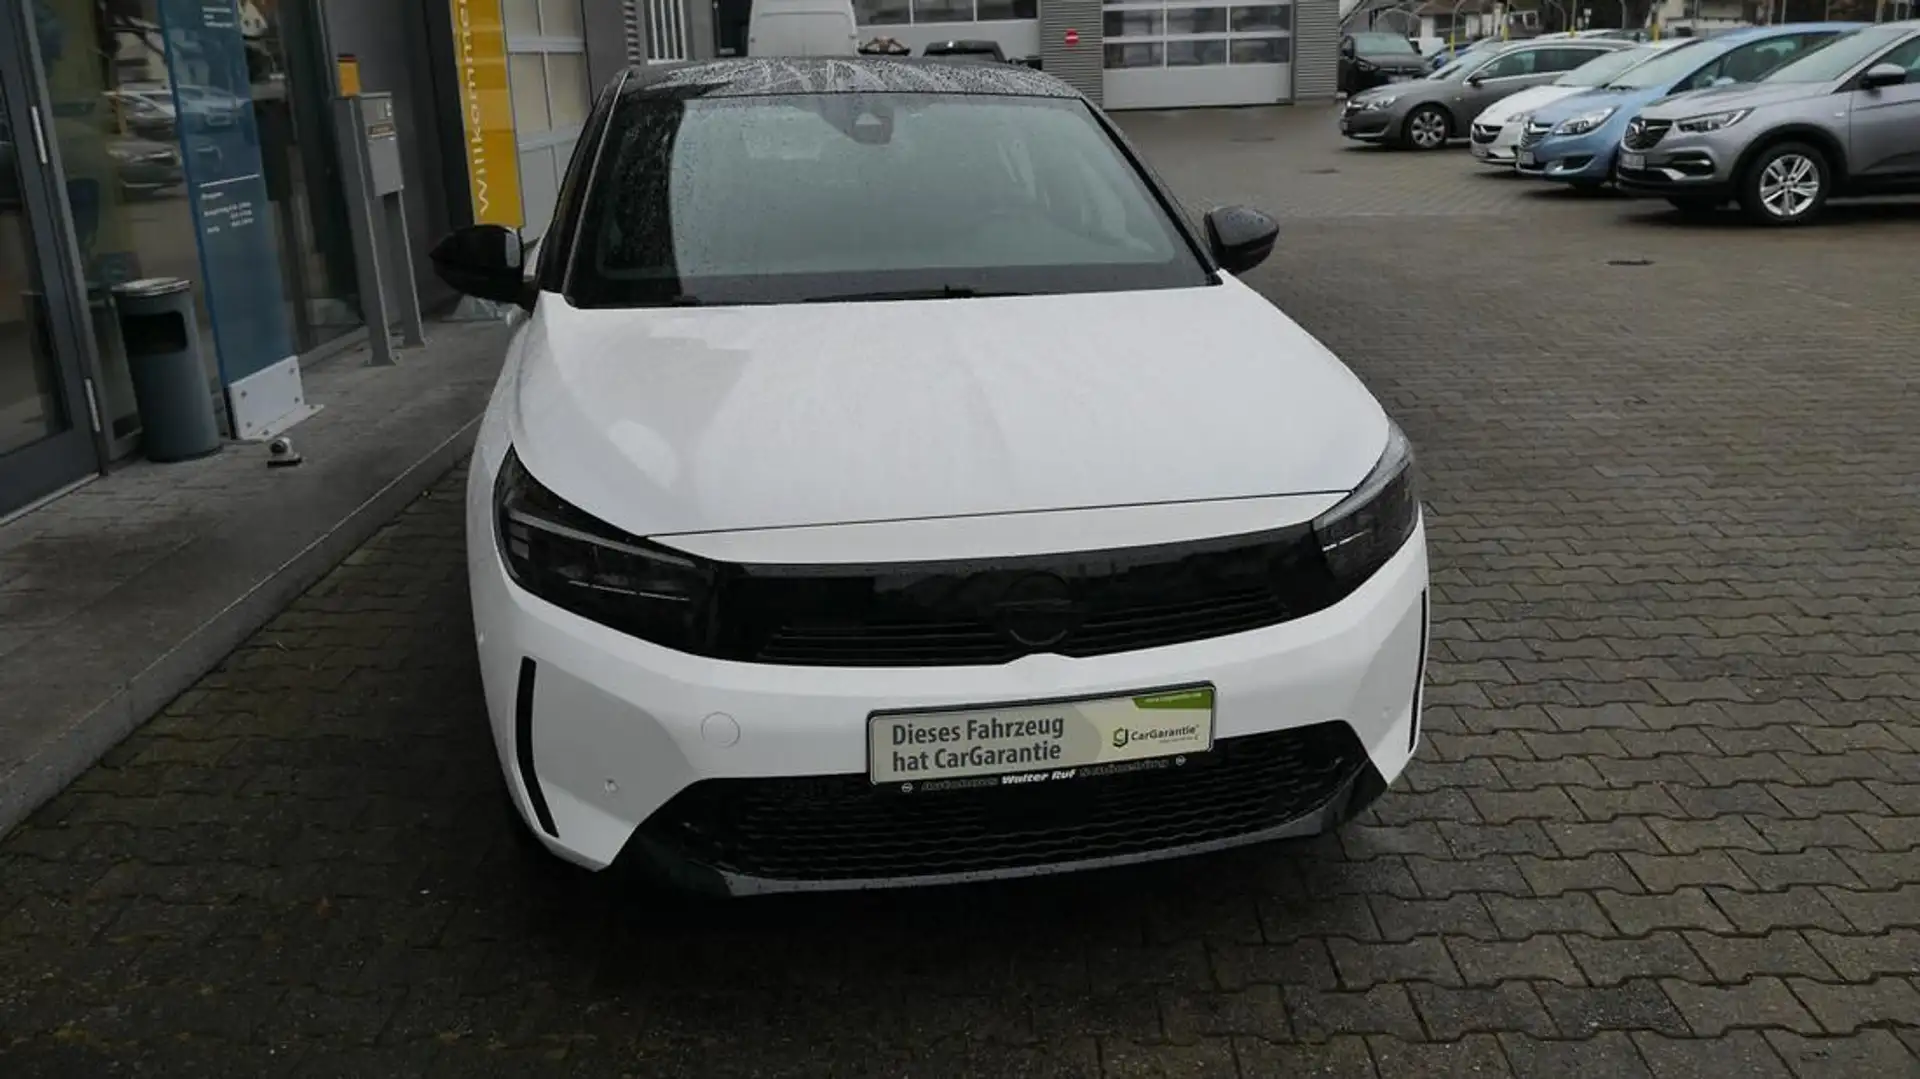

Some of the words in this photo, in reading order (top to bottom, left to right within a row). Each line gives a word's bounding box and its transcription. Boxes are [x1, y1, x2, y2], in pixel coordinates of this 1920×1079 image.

[892, 723, 961, 746] Dieses
[966, 717, 1065, 741] Fahrzeug
[1130, 724, 1196, 741] CarGarantie
[892, 750, 929, 772] hat
[934, 740, 1062, 769] CarGarantie
[1051, 768, 1077, 781] Ruf
